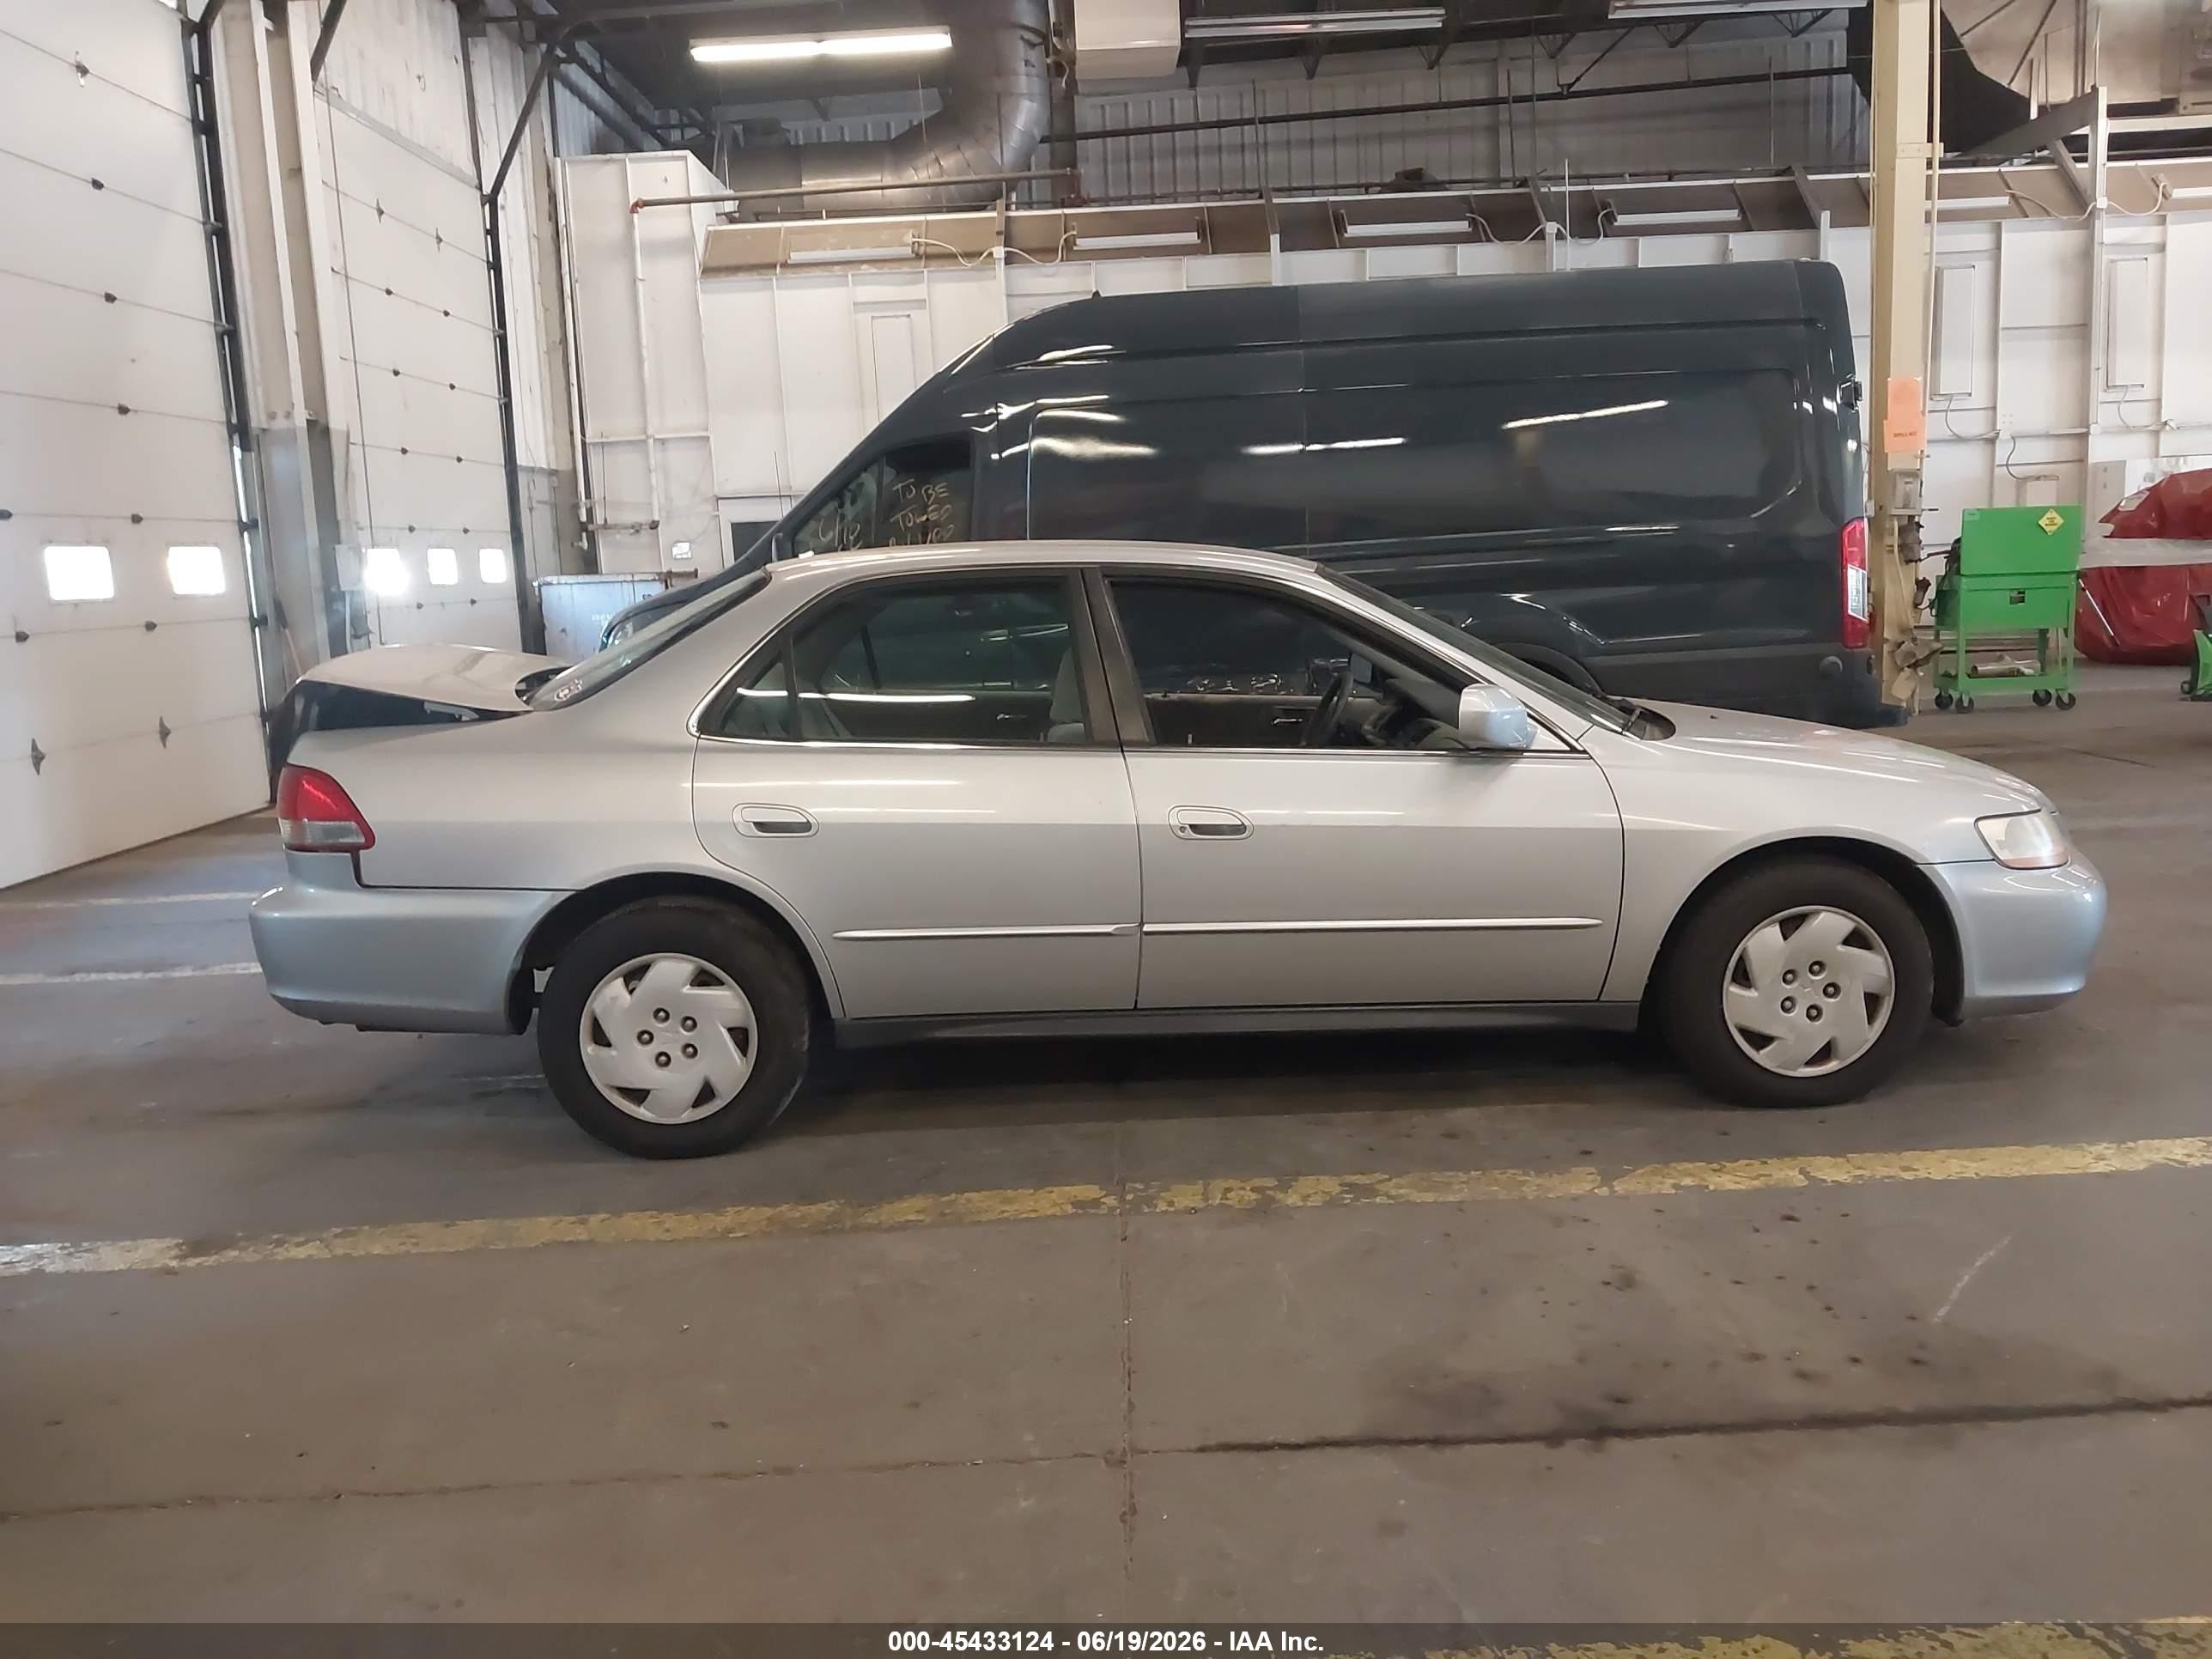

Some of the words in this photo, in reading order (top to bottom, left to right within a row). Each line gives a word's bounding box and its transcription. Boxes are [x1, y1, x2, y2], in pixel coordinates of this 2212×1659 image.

[893, 478, 916, 501] TO
[921, 483, 949, 505] BE
[890, 503, 952, 532] TOWED
